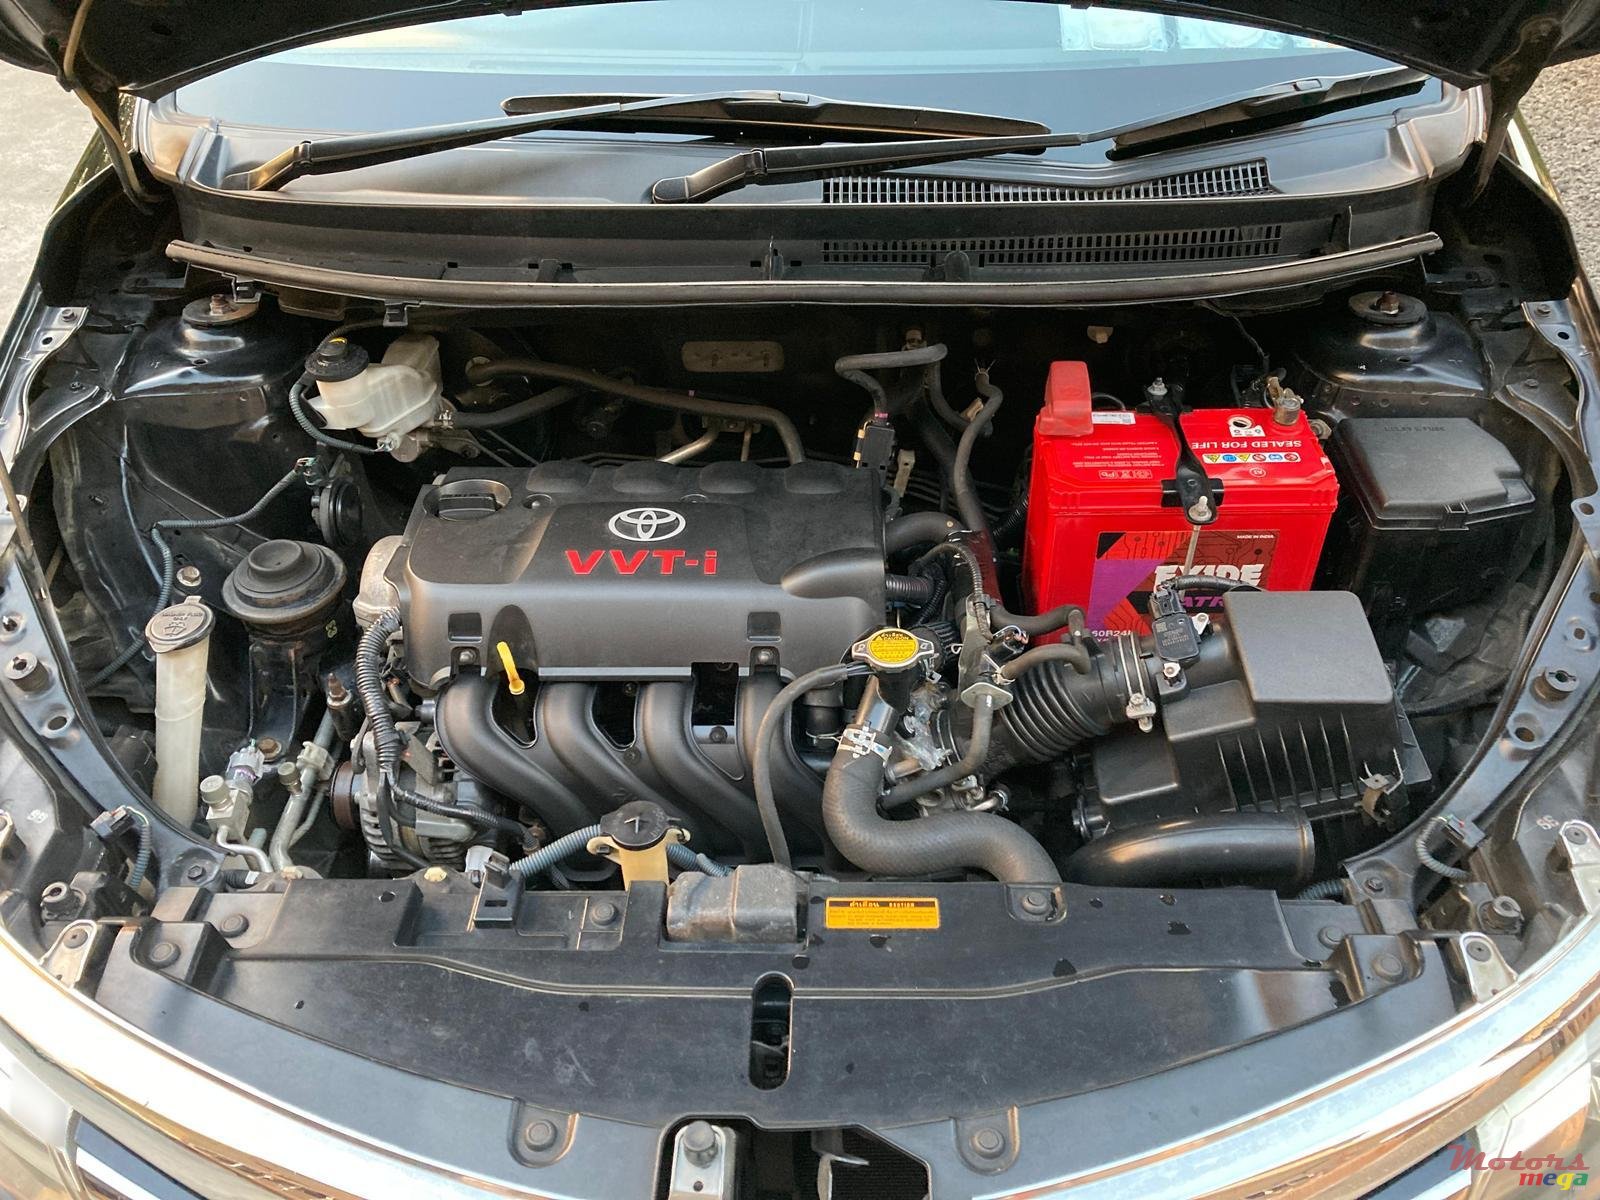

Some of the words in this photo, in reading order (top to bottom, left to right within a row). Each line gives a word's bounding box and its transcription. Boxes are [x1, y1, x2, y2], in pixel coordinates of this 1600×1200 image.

[1221, 441, 1248, 449] FOR
[1251, 440, 1302, 448] SEALED
[565, 550, 718, 576] VVT-i
